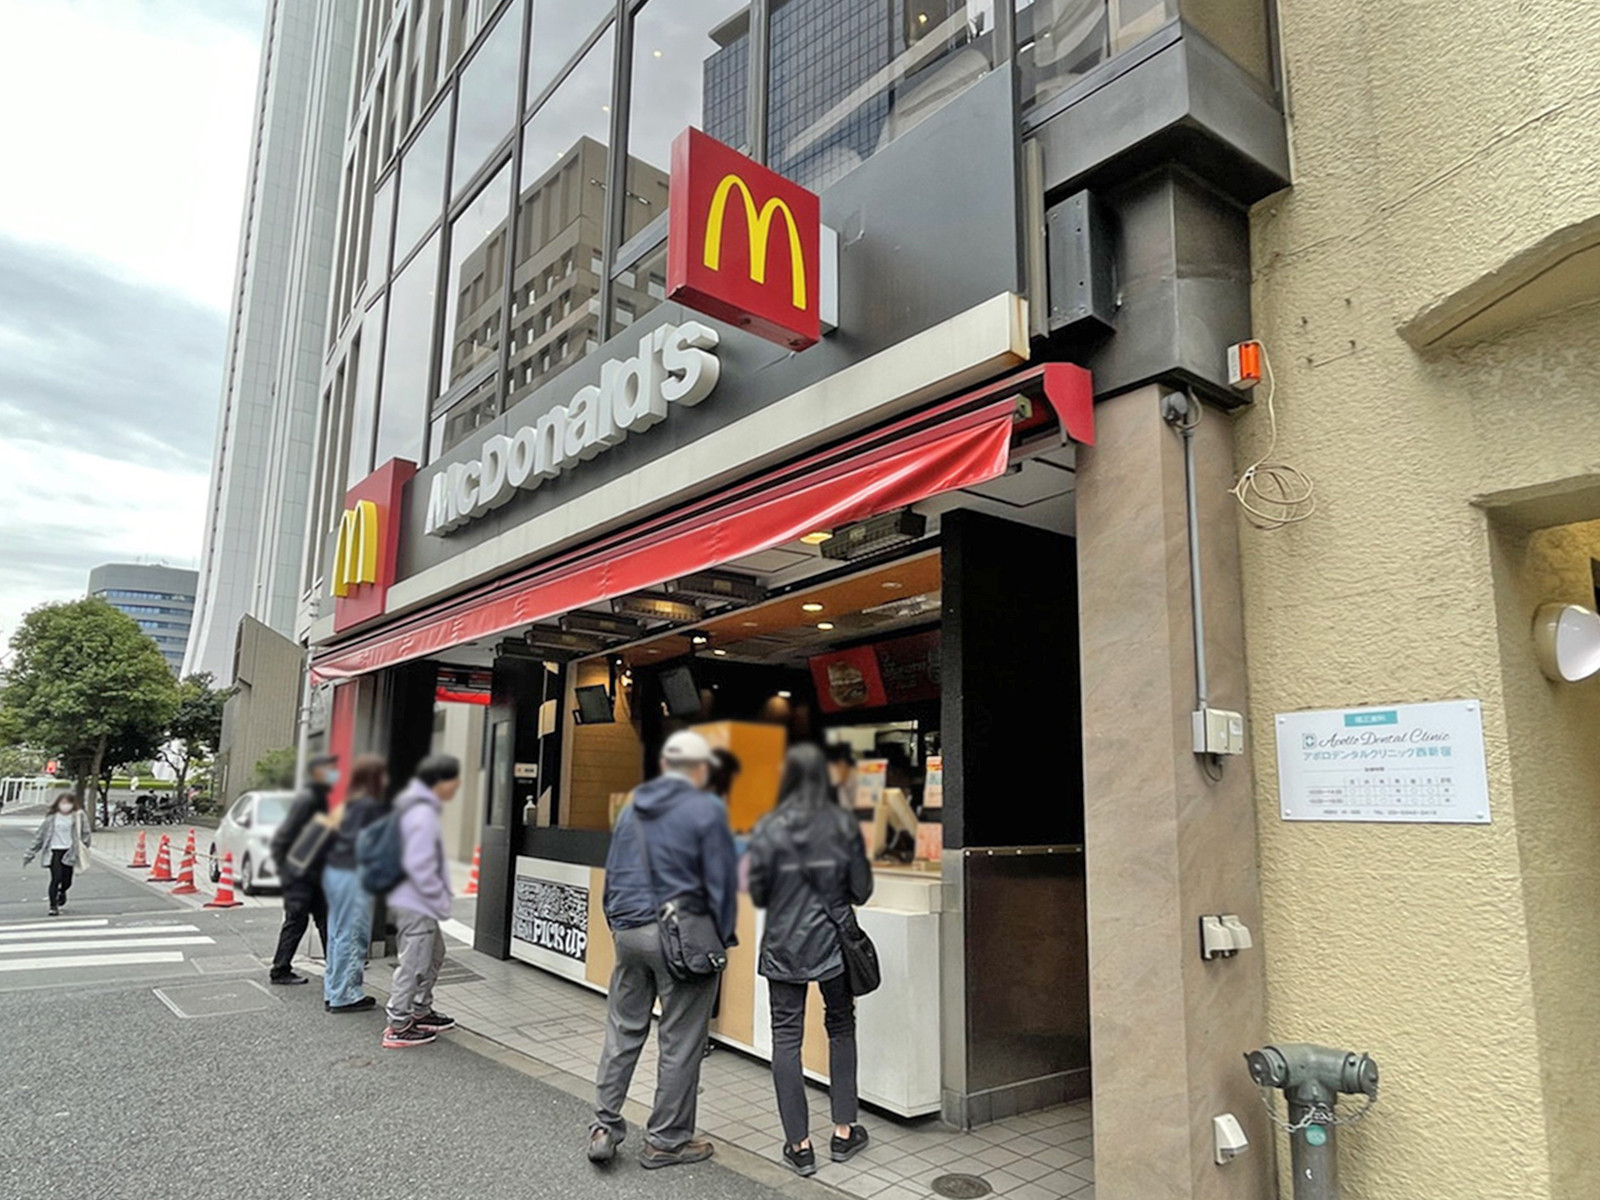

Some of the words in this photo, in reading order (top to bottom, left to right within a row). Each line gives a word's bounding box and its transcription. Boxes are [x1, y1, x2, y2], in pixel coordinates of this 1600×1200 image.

[423, 320, 721, 538] McDonald's
[1360, 731, 1408, 746] Dental
[1409, 727, 1450, 744] Clinic
[534, 917, 564, 949] PICK
[565, 927, 587, 958] UP
